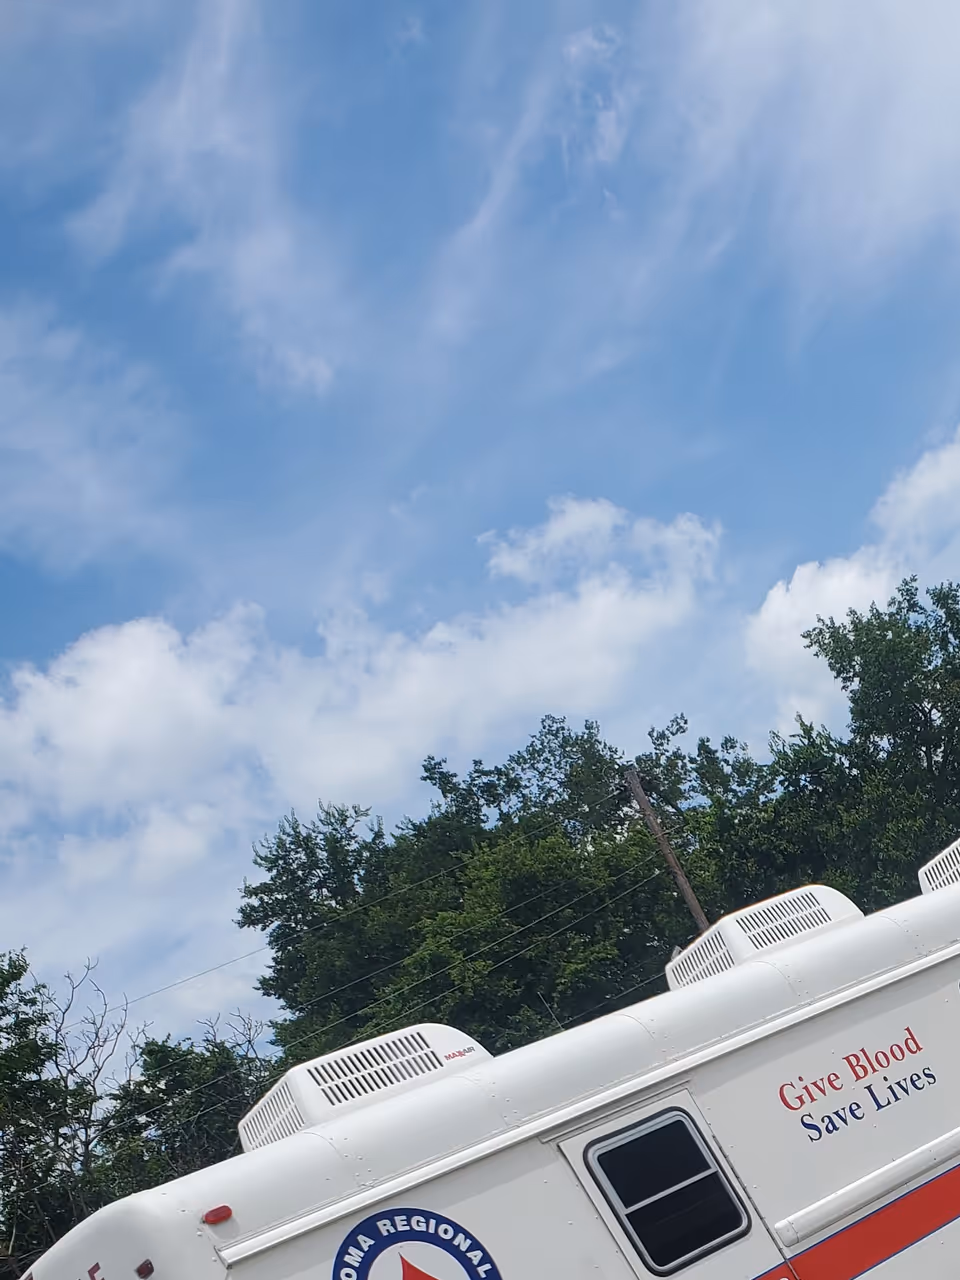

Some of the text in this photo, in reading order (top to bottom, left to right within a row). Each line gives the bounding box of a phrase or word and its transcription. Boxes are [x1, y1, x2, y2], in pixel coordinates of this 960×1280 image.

[778, 1026, 923, 1111] Give Blood
[800, 1066, 937, 1142] Save Lives
[376, 1215, 492, 1278] REGIONAL
